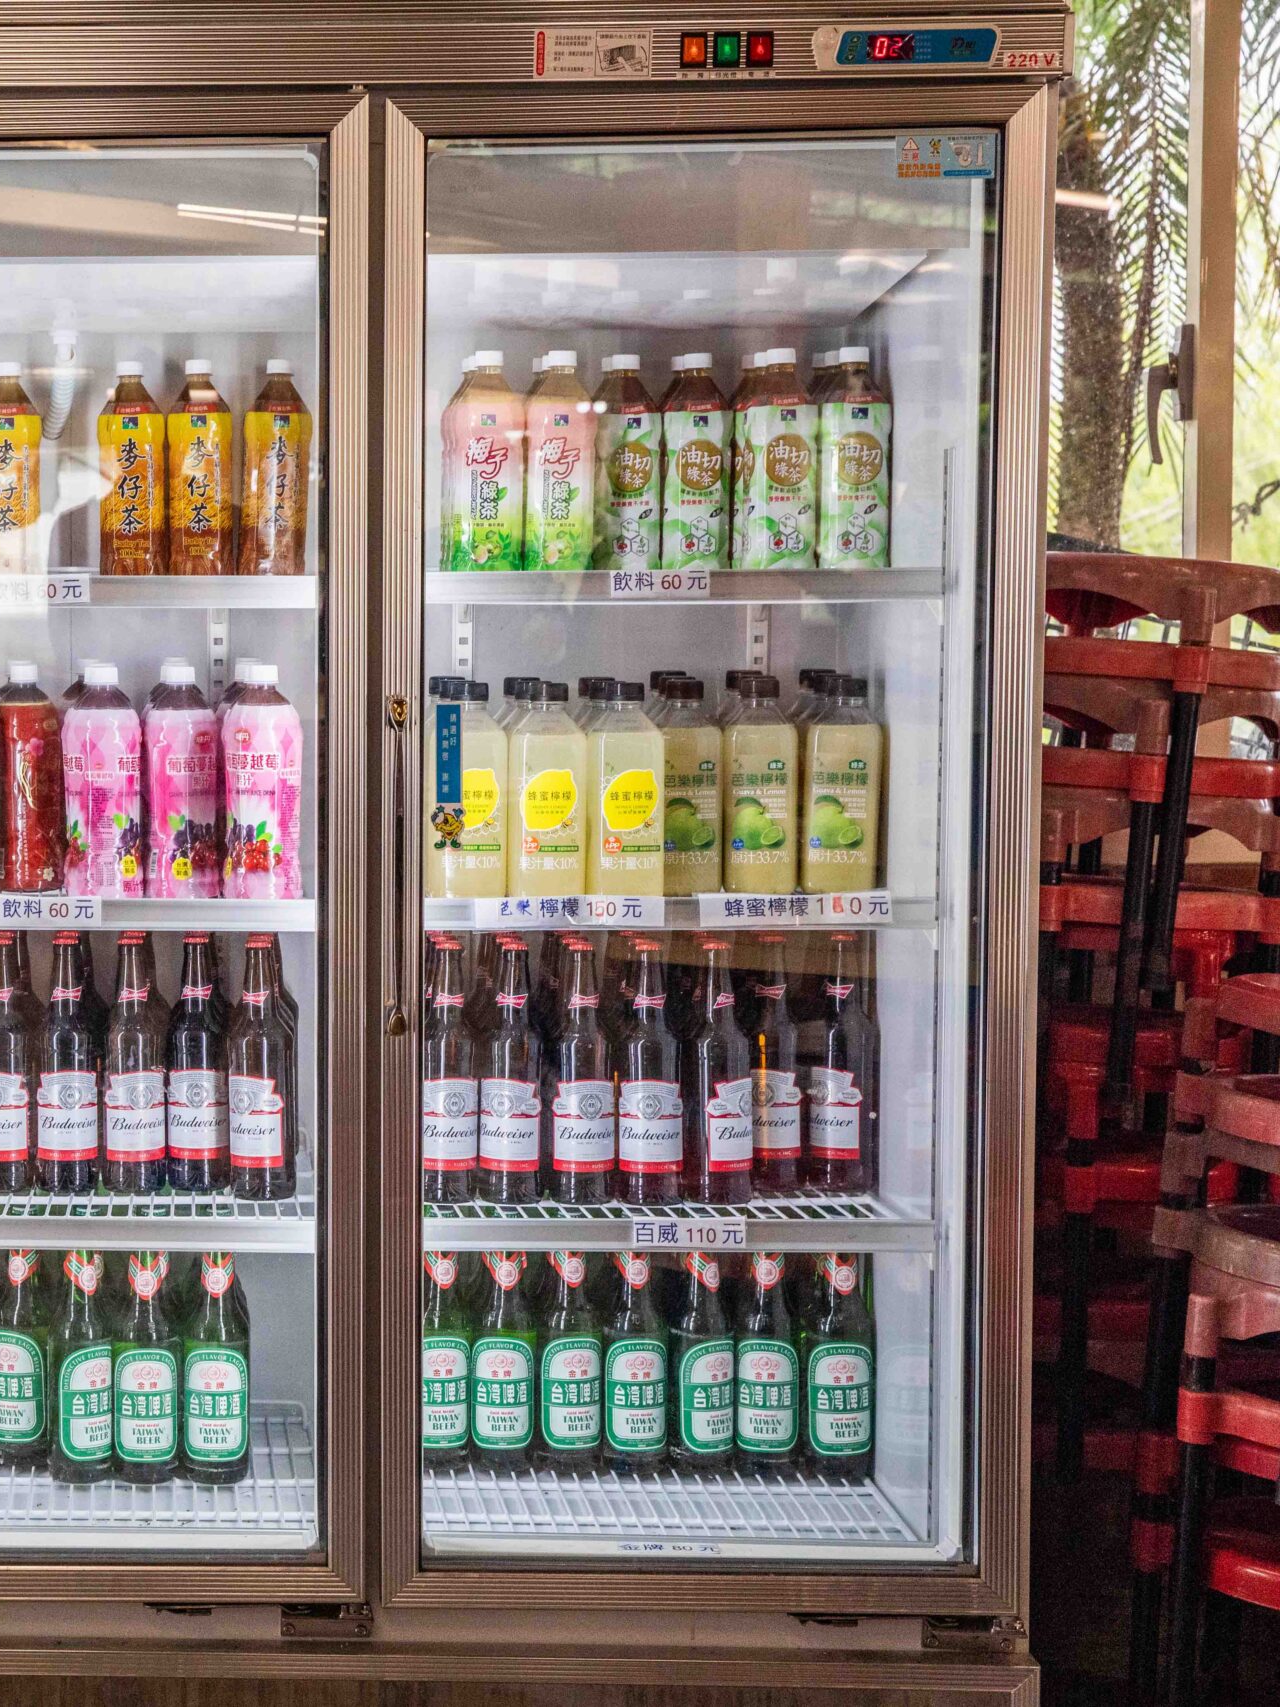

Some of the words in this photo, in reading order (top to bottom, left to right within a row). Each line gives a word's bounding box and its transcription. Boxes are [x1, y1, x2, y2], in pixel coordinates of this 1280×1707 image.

[875, 38, 904, 58] 02
[1007, 54, 1038, 67] 220
[1044, 53, 1056, 66] V
[769, 440, 809, 464] 油切
[839, 438, 881, 463] 油切
[466, 437, 508, 479] 梅子
[538, 437, 580, 479] 梅子
[682, 445, 721, 470] 油切
[687, 466, 713, 487] 綠茶
[775, 462, 801, 482] 綠茶
[844, 460, 873, 481] 綠茶
[117, 438, 147, 536] 麥仔茶
[187, 436, 213, 534] 麥仔茶
[480, 480, 498, 519] 綠茶
[552, 480, 570, 519] 綠茶
[613, 572, 654, 591] 飲料
[661, 574, 681, 590] 60
[688, 571, 707, 591] 元
[62, 579, 82, 599] 元
[664, 773, 718, 788] 芭樂檸檬
[731, 772, 788, 787] 芭樂檸檬
[812, 772, 869, 787] 芭樂檸檬
[528, 790, 572, 801] 蜂蜜檸檬
[611, 790, 654, 801] 蜂蜜檸檬
[664, 851, 719, 865] 原汁33.7%
[731, 851, 789, 864] 原汁33.7%
[808, 851, 867, 864] 原汁33.7%
[2, 899, 42, 918] 飲料
[49, 902, 69, 918] 60
[75, 899, 94, 919] 元
[586, 901, 617, 917] 150
[623, 899, 642, 918] 元
[725, 898, 808, 917] 蜂蜜檸檬
[868, 896, 889, 915] 元
[41, 1115, 96, 1129] Budweiser
[171, 1115, 226, 1128] Budweiser
[480, 1124, 535, 1138] Budweiser
[621, 1126, 680, 1140] Budweiser
[634, 1222, 679, 1244] 百威
[686, 1228, 716, 1243] 110
[722, 1223, 744, 1244] 元
[630, 1371, 651, 1380] 金牌
[755, 1371, 776, 1380] 金牌
[137, 1381, 158, 1390] 金牌
[204, 1381, 225, 1390] 金牌
[0, 1417, 21, 1426] BEER
[428, 1413, 459, 1422] TAIWAN
[487, 1415, 519, 1424] TAIWAN
[563, 1415, 594, 1424] TAIWAN
[625, 1416, 657, 1426] TAIWAN
[749, 1416, 782, 1426] TAIWAN
[132, 1427, 164, 1436] TAIWAN
[199, 1427, 230, 1436] TAIWAN
[432, 1422, 456, 1430] BEER
[491, 1423, 516, 1432] BEER
[568, 1423, 591, 1432] BEER
[630, 1425, 655, 1434] BEER
[754, 1425, 778, 1435] BEER
[830, 1421, 862, 1430] TAIWAN
[89, 1433, 109, 1443] BEER
[136, 1436, 161, 1445] BEER
[203, 1436, 227, 1444] BEER
[834, 1430, 860, 1438] BEER
